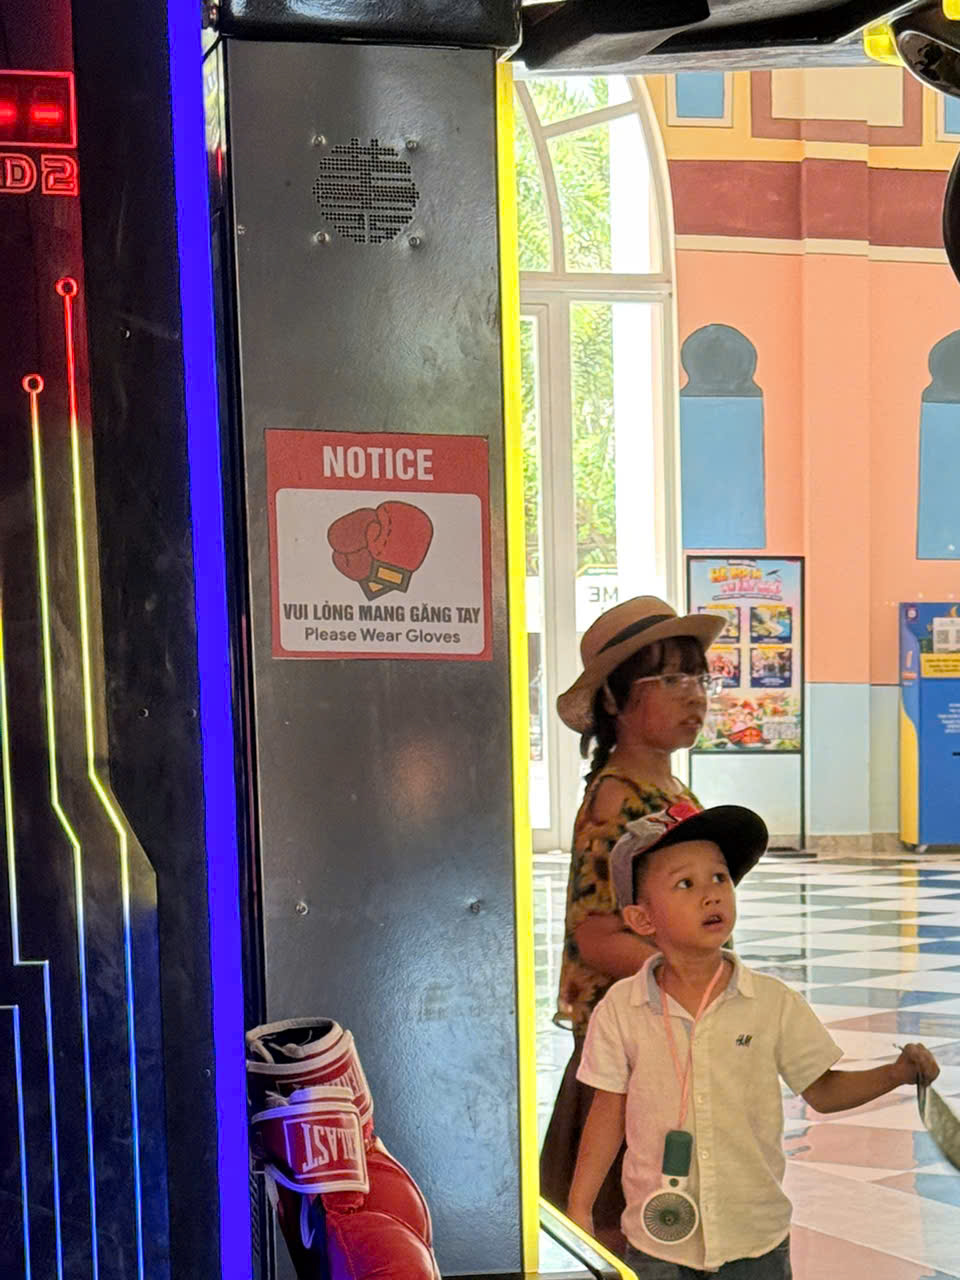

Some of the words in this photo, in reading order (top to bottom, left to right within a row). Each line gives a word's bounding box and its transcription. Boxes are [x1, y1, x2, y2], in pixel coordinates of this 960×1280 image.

[322, 446, 434, 481] NOTICE
[282, 603, 308, 620] VUI
[313, 600, 354, 621] LÒNG
[358, 604, 405, 622] MANG
[456, 607, 481, 624] TAY
[304, 627, 357, 642] Please
[360, 628, 402, 643] Wear
[405, 629, 461, 643] Gloves
